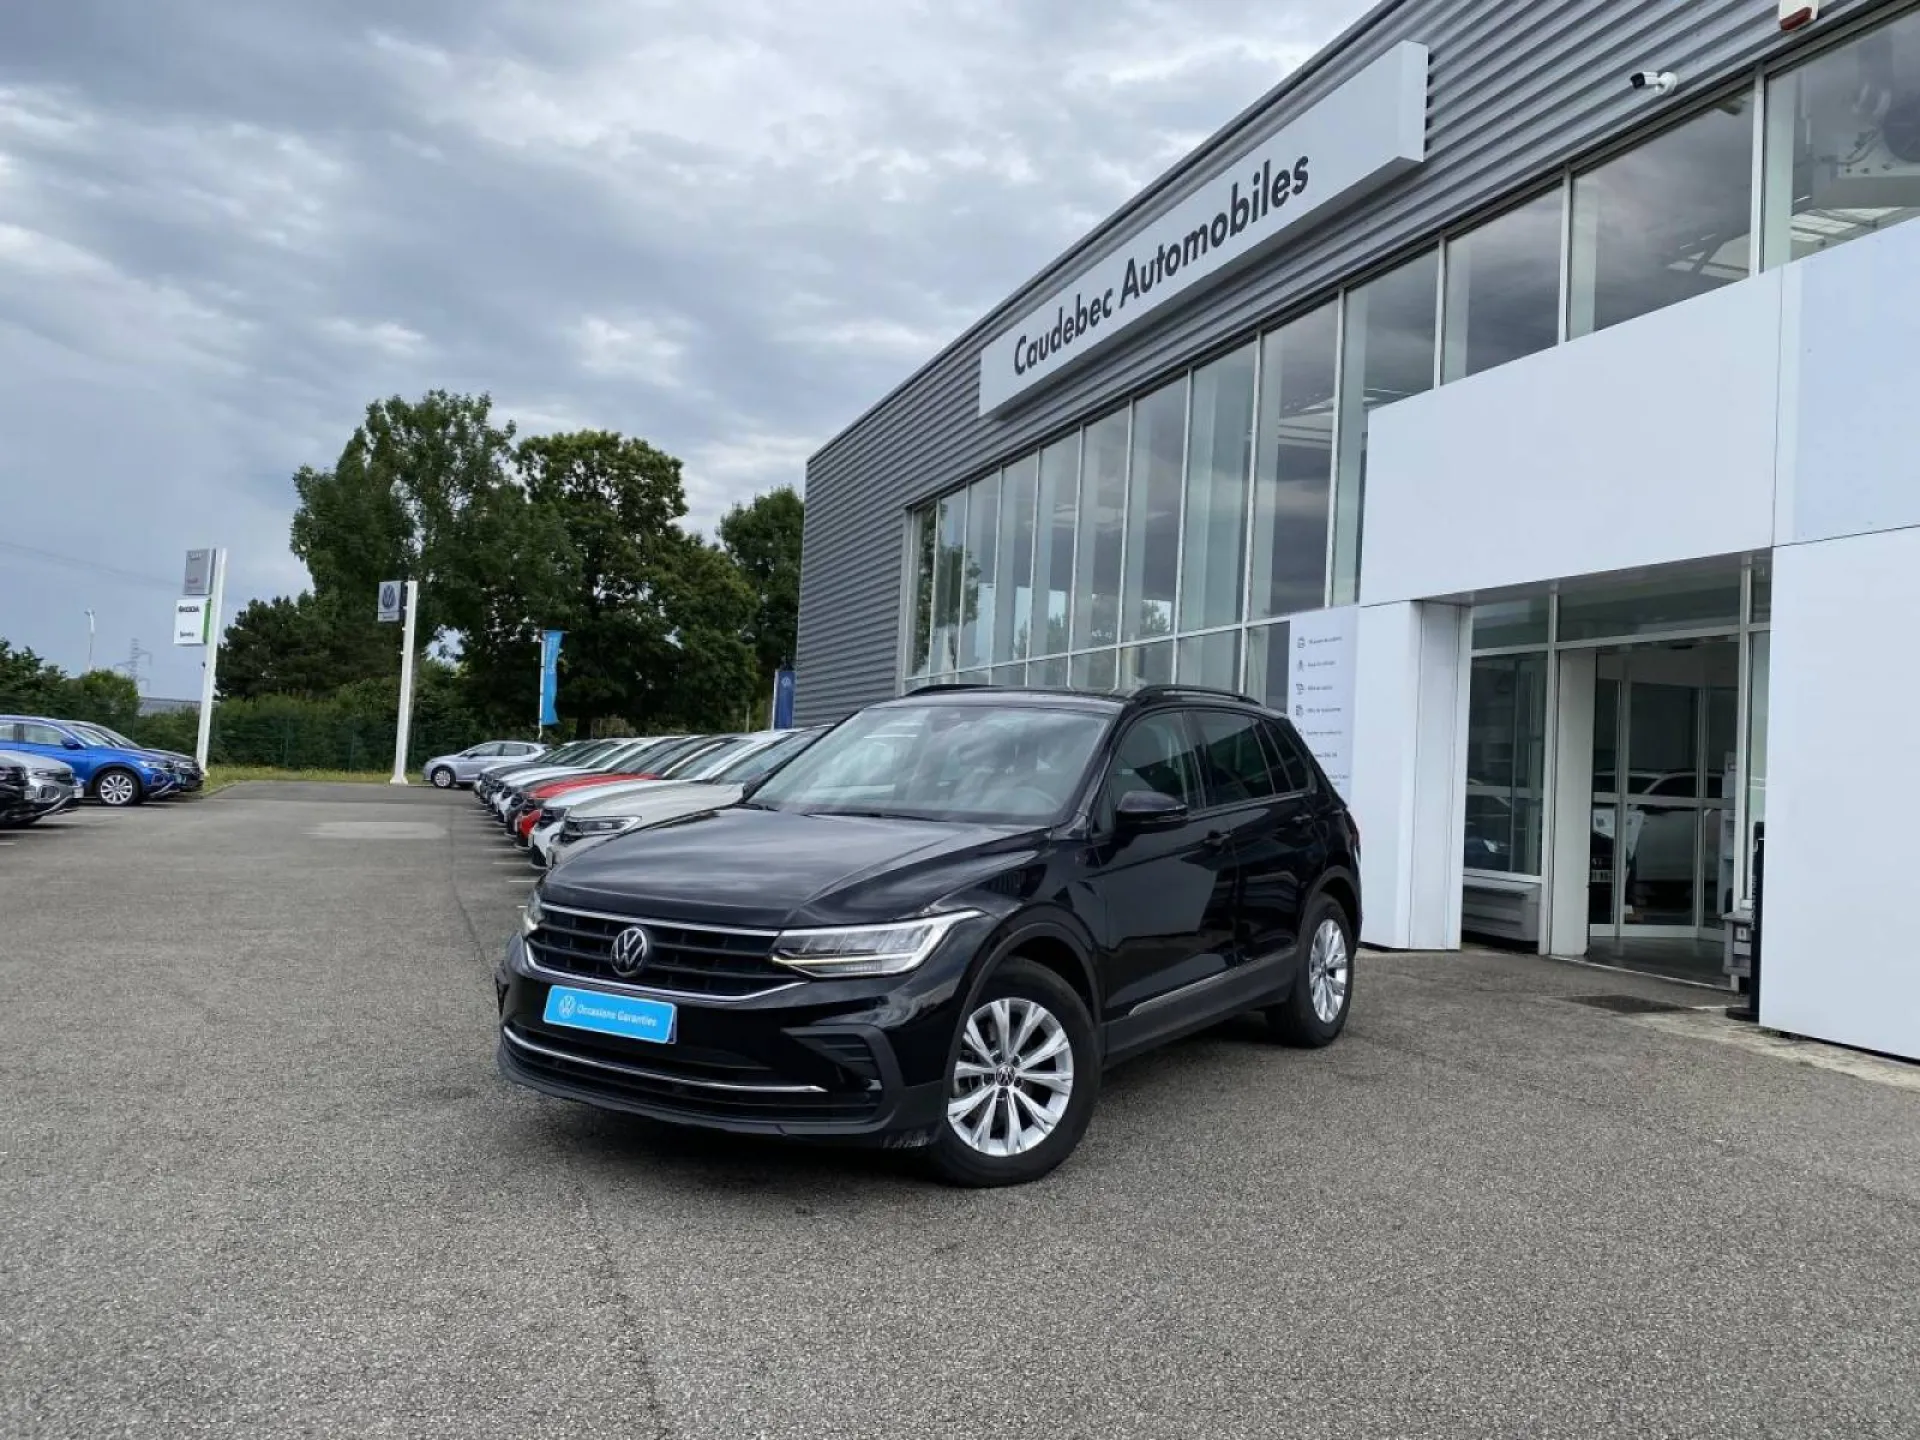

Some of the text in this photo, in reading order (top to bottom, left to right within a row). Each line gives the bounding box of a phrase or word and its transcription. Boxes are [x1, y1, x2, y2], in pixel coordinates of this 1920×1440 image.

[1013, 155, 1309, 376] Caudebec Automobiles
[576, 1002, 617, 1020] Occasions
